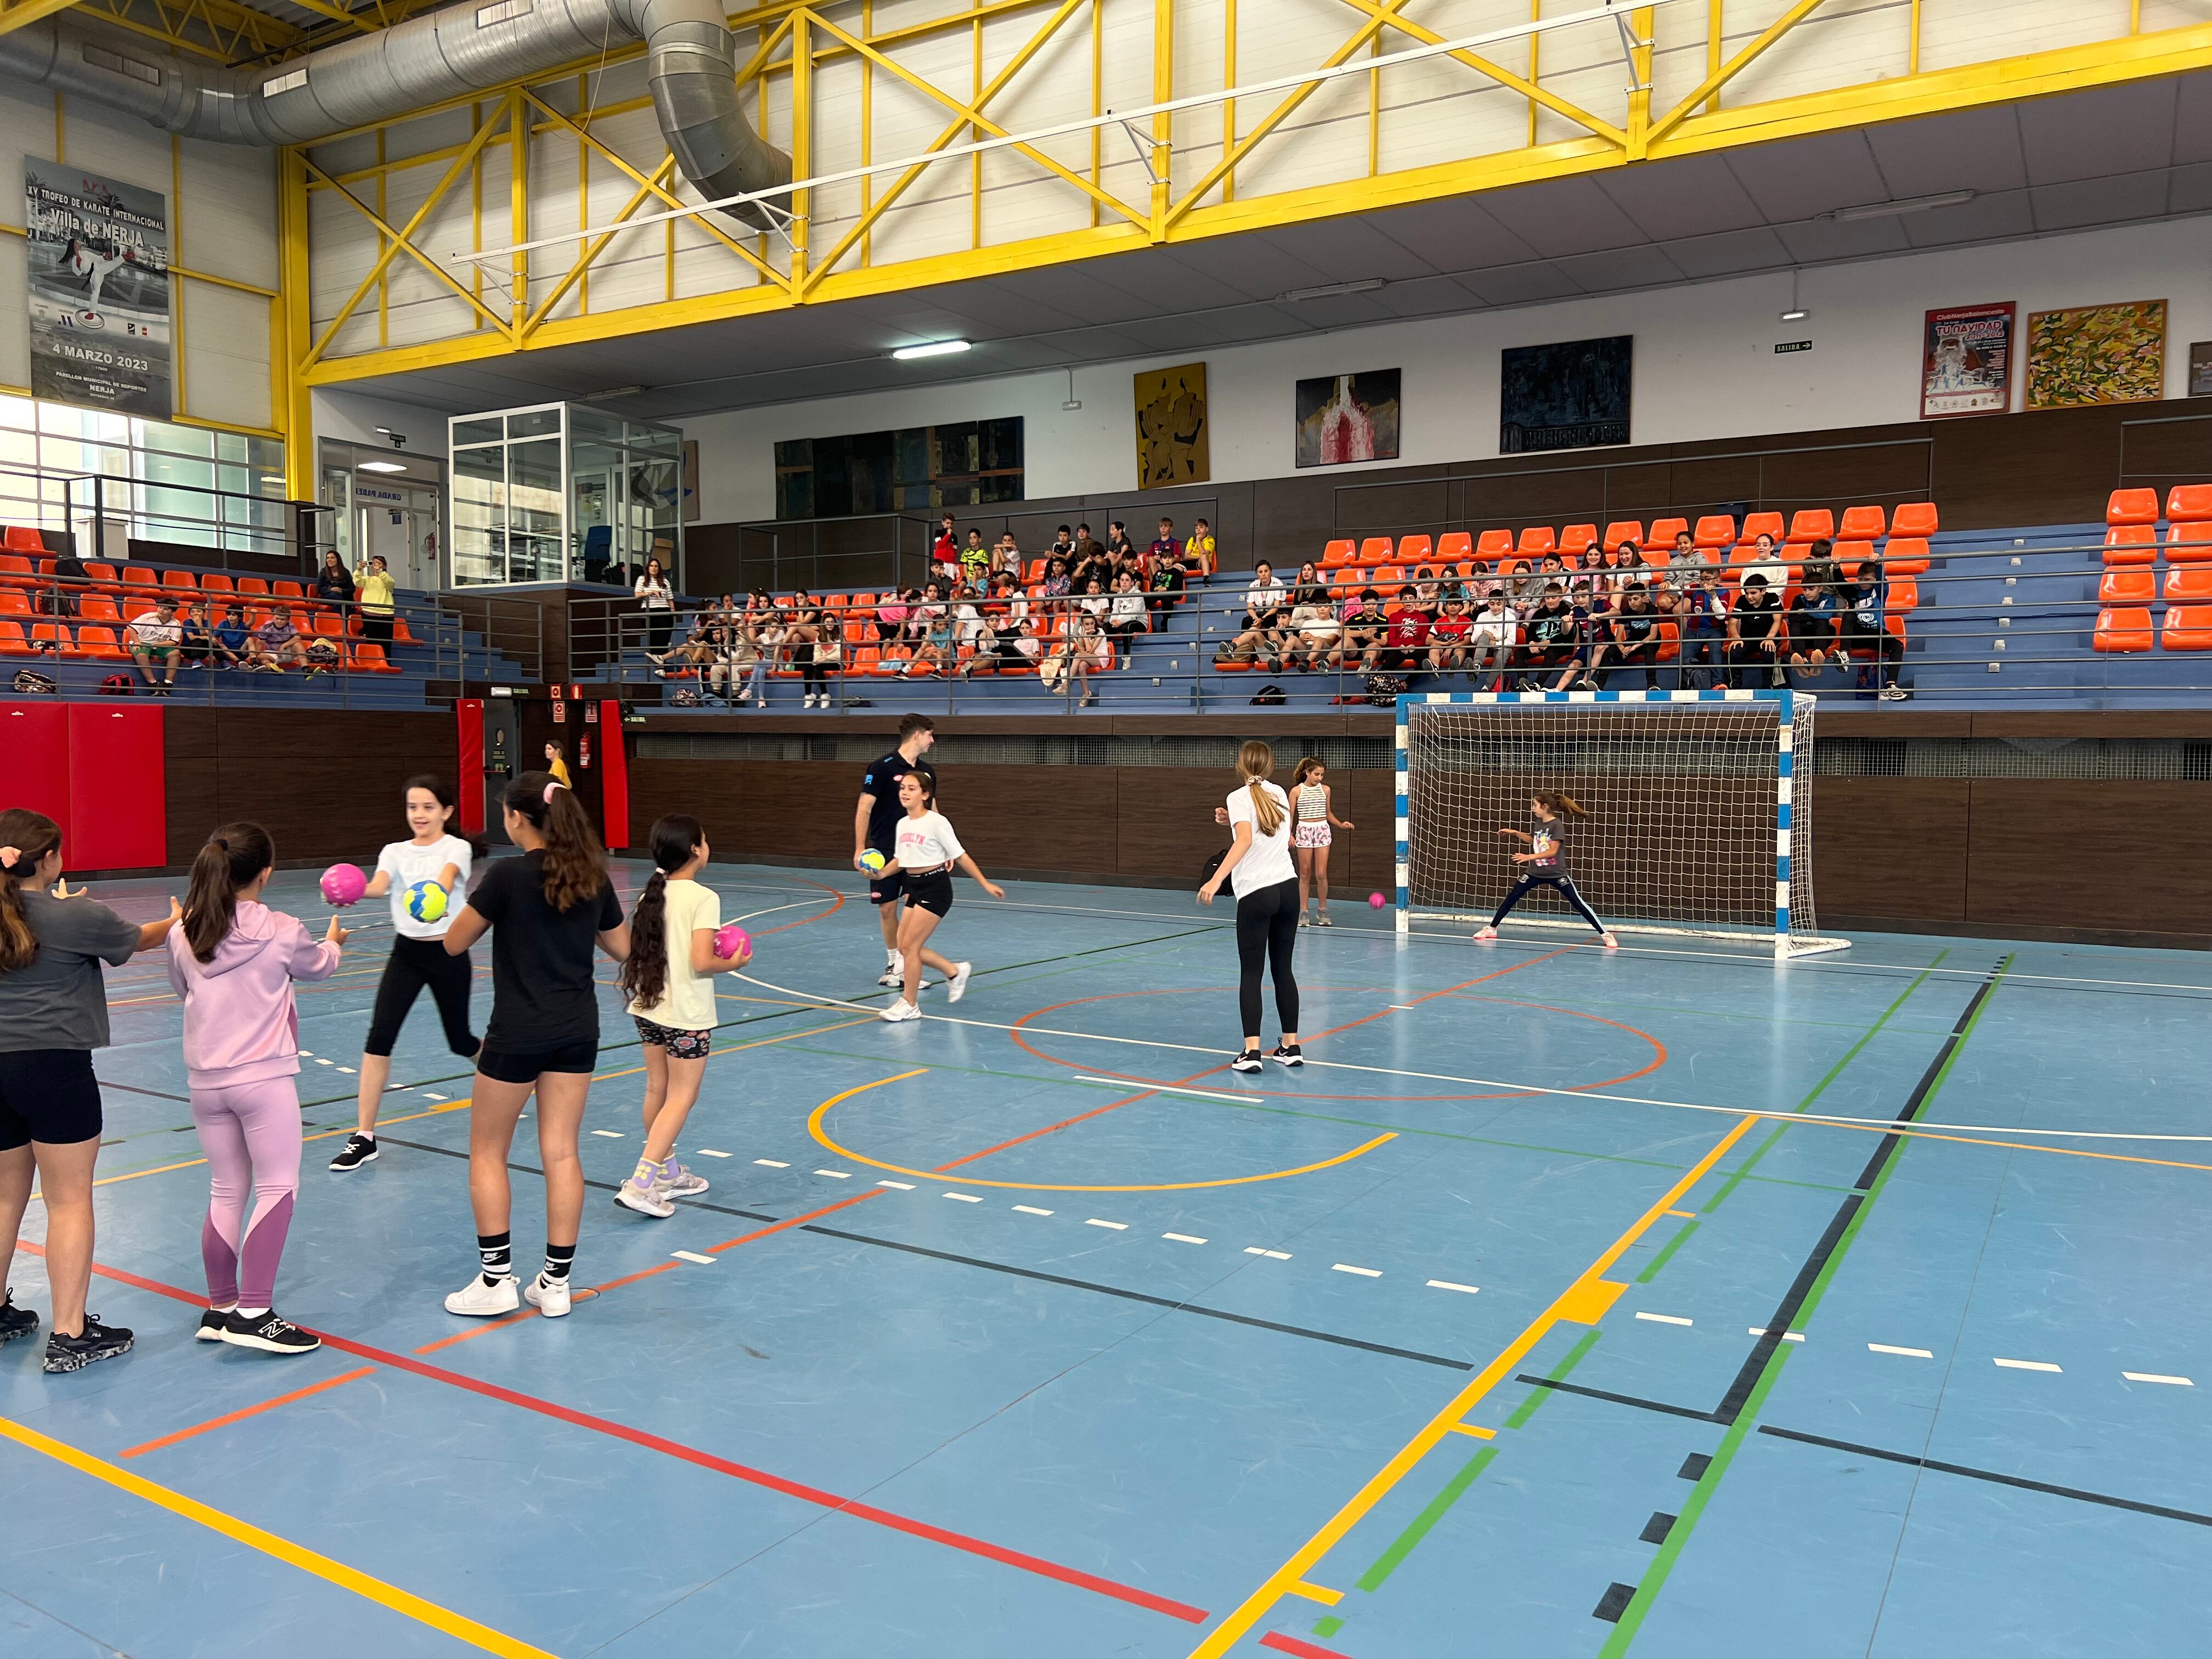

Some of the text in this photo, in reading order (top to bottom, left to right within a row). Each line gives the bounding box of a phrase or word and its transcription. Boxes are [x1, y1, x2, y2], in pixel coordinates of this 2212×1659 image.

[28, 185, 164, 230] XV TROFEO DE KARATE INTERNACIONAL
[50, 208, 144, 247] Villa de NERJA
[1936, 326, 1950, 336] TU
[52, 343, 149, 371] 4 MARZO 2023
[1777, 343, 1800, 352] SALIDA
[89, 384, 115, 394] NERJA
